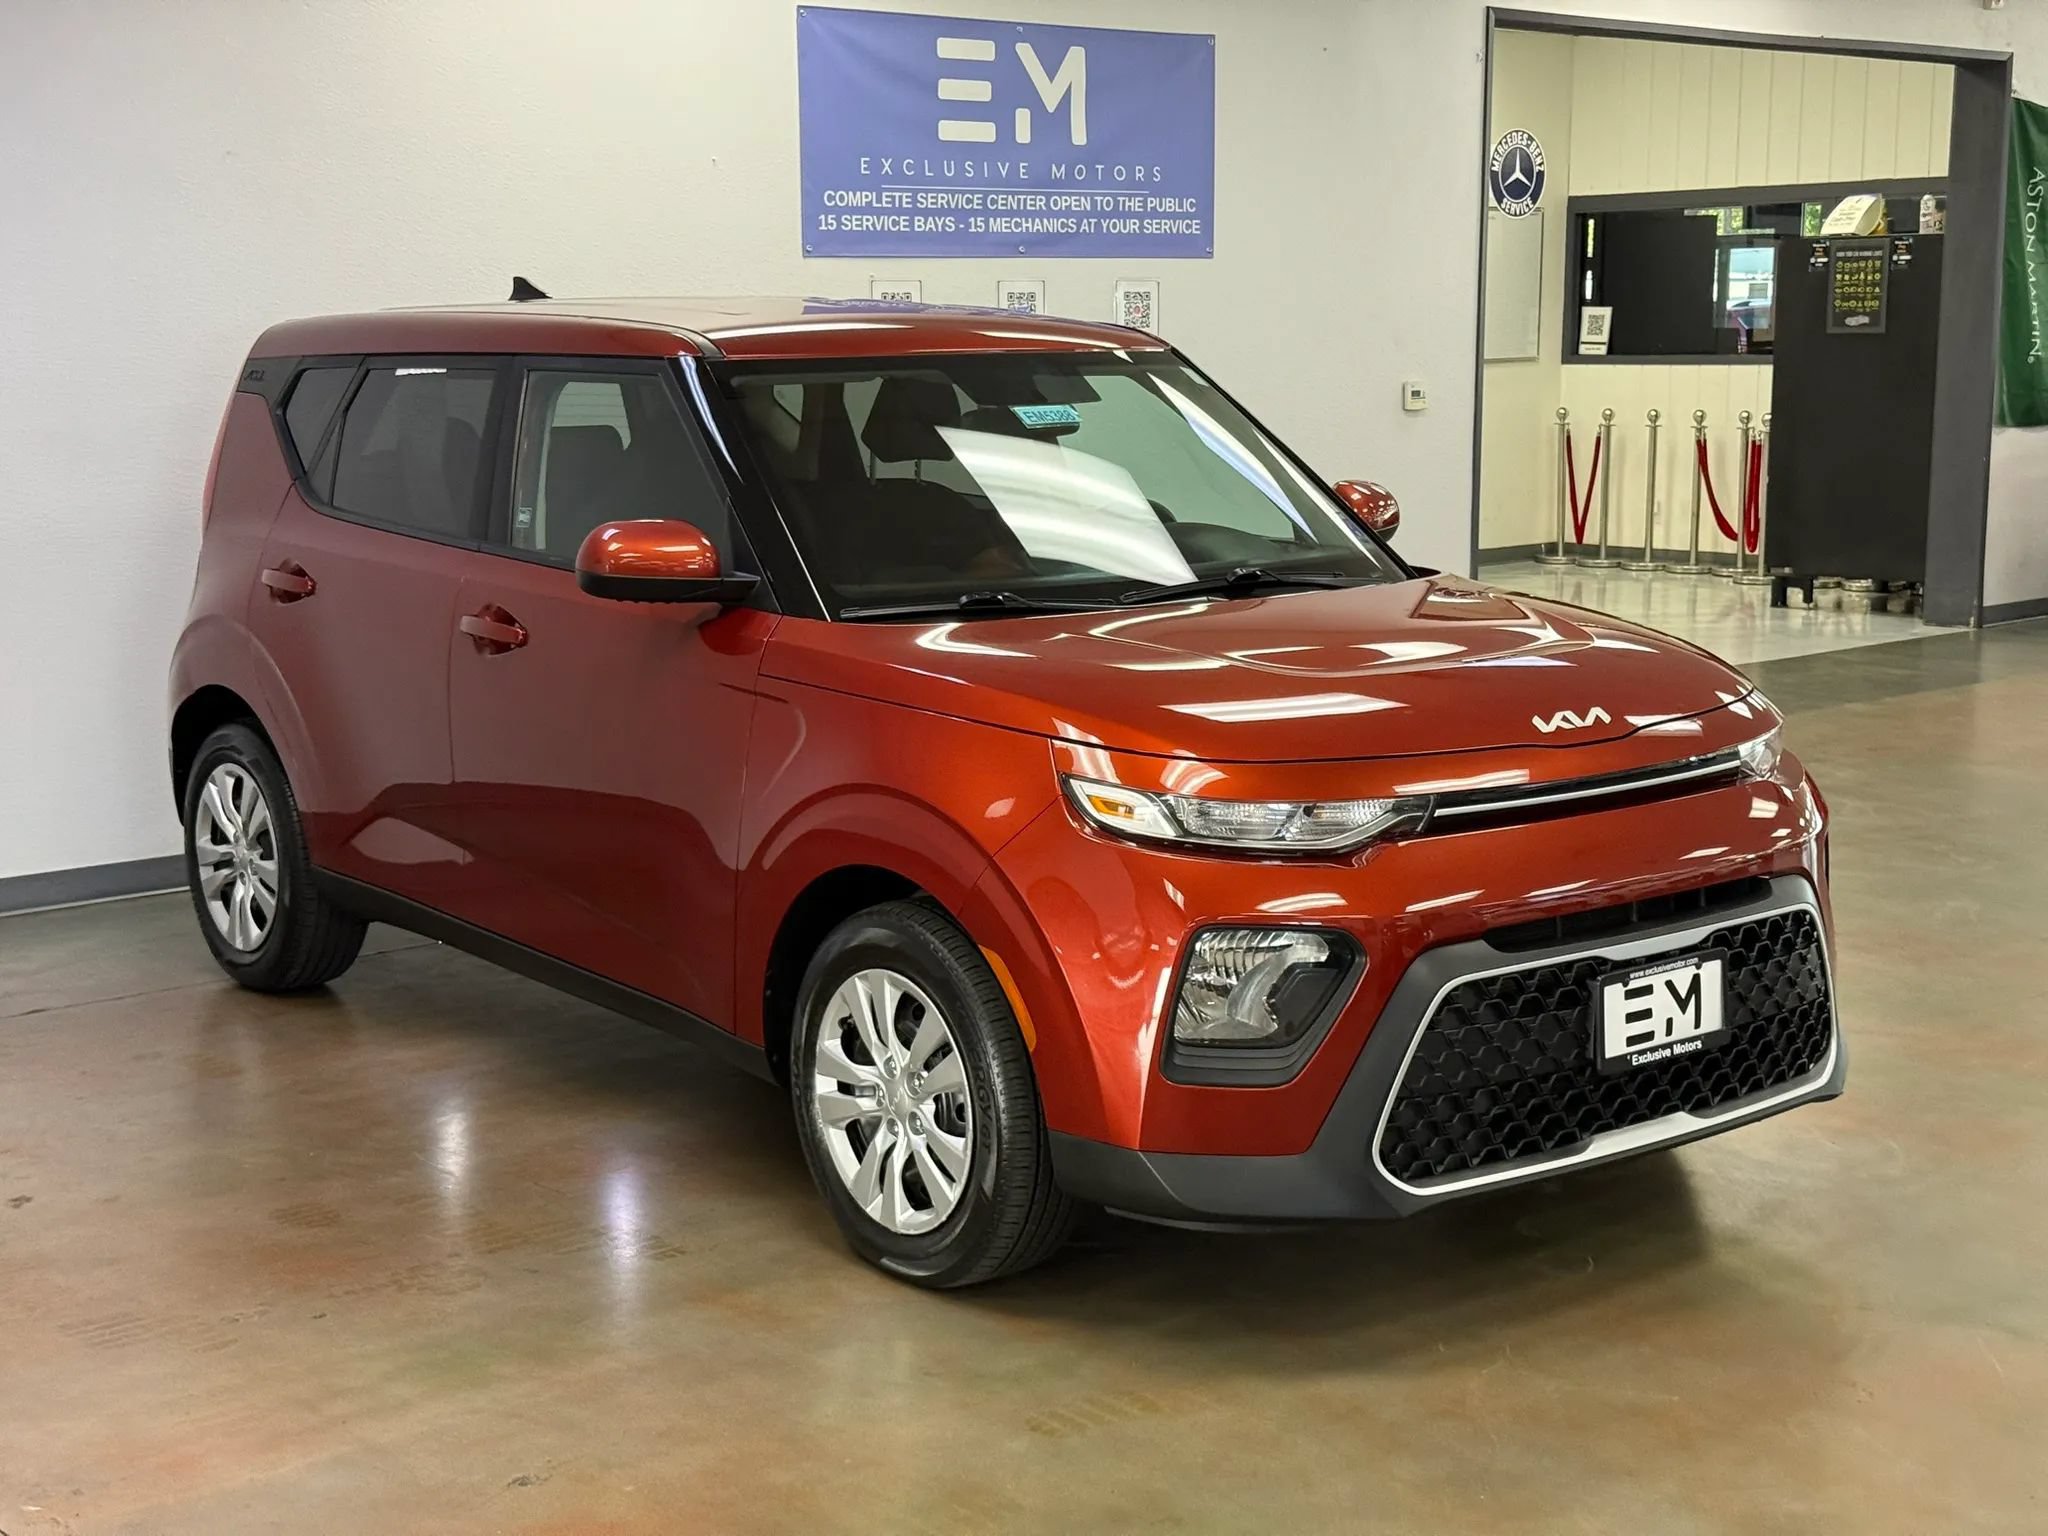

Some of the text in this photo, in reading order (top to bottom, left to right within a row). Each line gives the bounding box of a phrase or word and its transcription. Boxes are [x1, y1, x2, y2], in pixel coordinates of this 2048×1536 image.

[937, 37, 1087, 145] EM
[860, 157, 1162, 182] EXCLUSIVE MOTORS
[823, 190, 1197, 213] COMPLETE SERVICE CENTER OPEN TO THE PUBLIC
[1501, 196, 1534, 215] SERVICE
[818, 214, 837, 231] 15
[840, 214, 910, 232] SERVICE
[914, 215, 956, 233] BAYS
[968, 216, 985, 232] 15
[988, 217, 1077, 234] MECHANICS
[1079, 218, 1099, 233] AT
[1100, 218, 1141, 235] YOUR
[1143, 219, 1201, 235] SERVICE
[2025, 166, 2046, 356] ASTON MARTIN
[1532, 706, 1611, 733] KIA
[1624, 972, 1701, 1048] EM
[1631, 1040, 1703, 1066] Exclusive Motors
